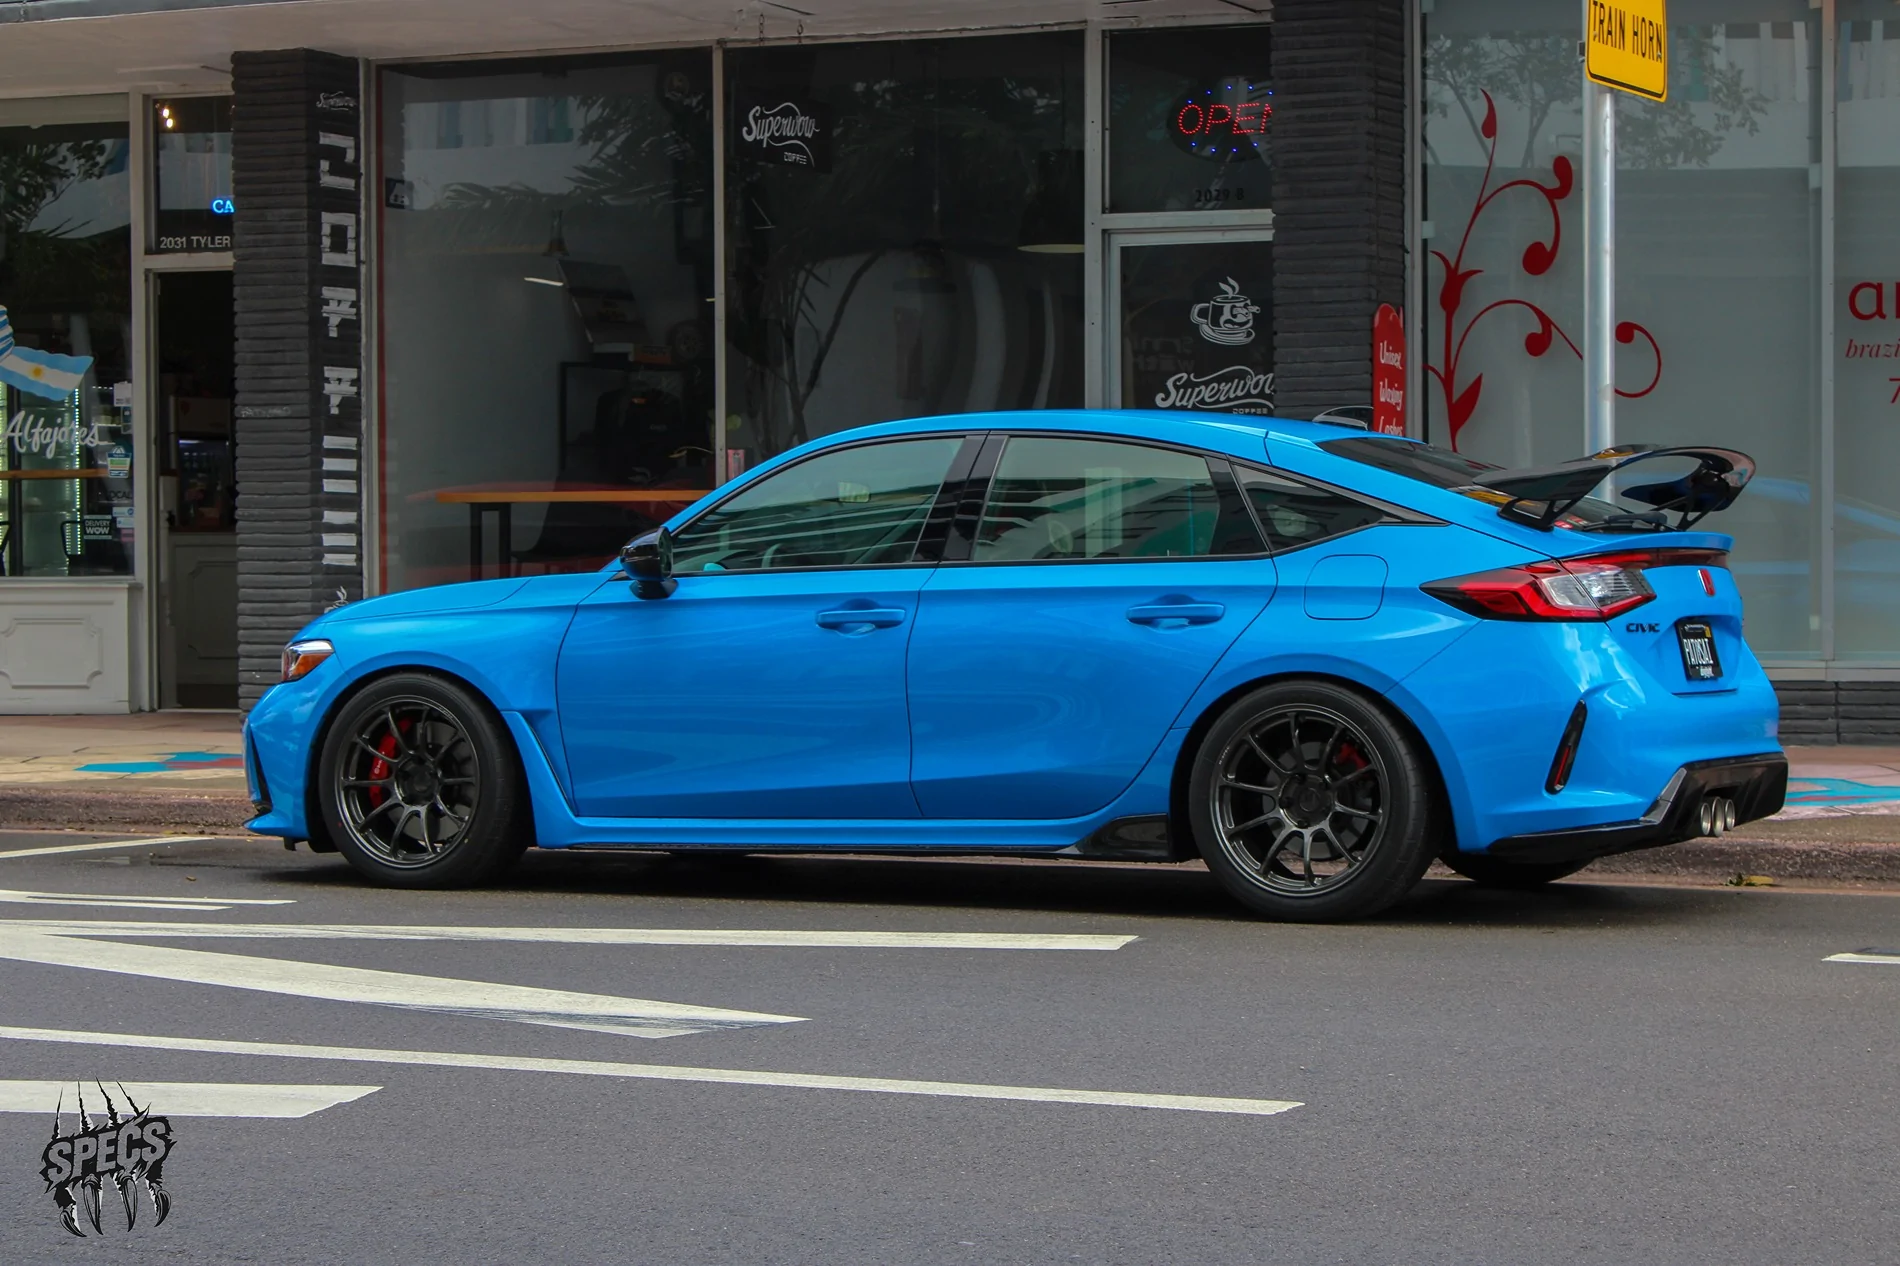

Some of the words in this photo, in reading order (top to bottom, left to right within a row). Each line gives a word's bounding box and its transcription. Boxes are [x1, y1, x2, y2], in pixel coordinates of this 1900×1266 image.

[1593, 0, 1626, 51] TRAIN
[1632, 14, 1662, 63] HORN
[742, 103, 820, 148] Superwow
[784, 151, 807, 165] COFFEE
[160, 236, 187, 249] 2031
[191, 235, 231, 248] TYLER
[1379, 340, 1402, 369] Unisex
[3, 410, 102, 459] Alfajores
[85, 526, 110, 535] WOW
[1626, 622, 1660, 633] CIVIC
